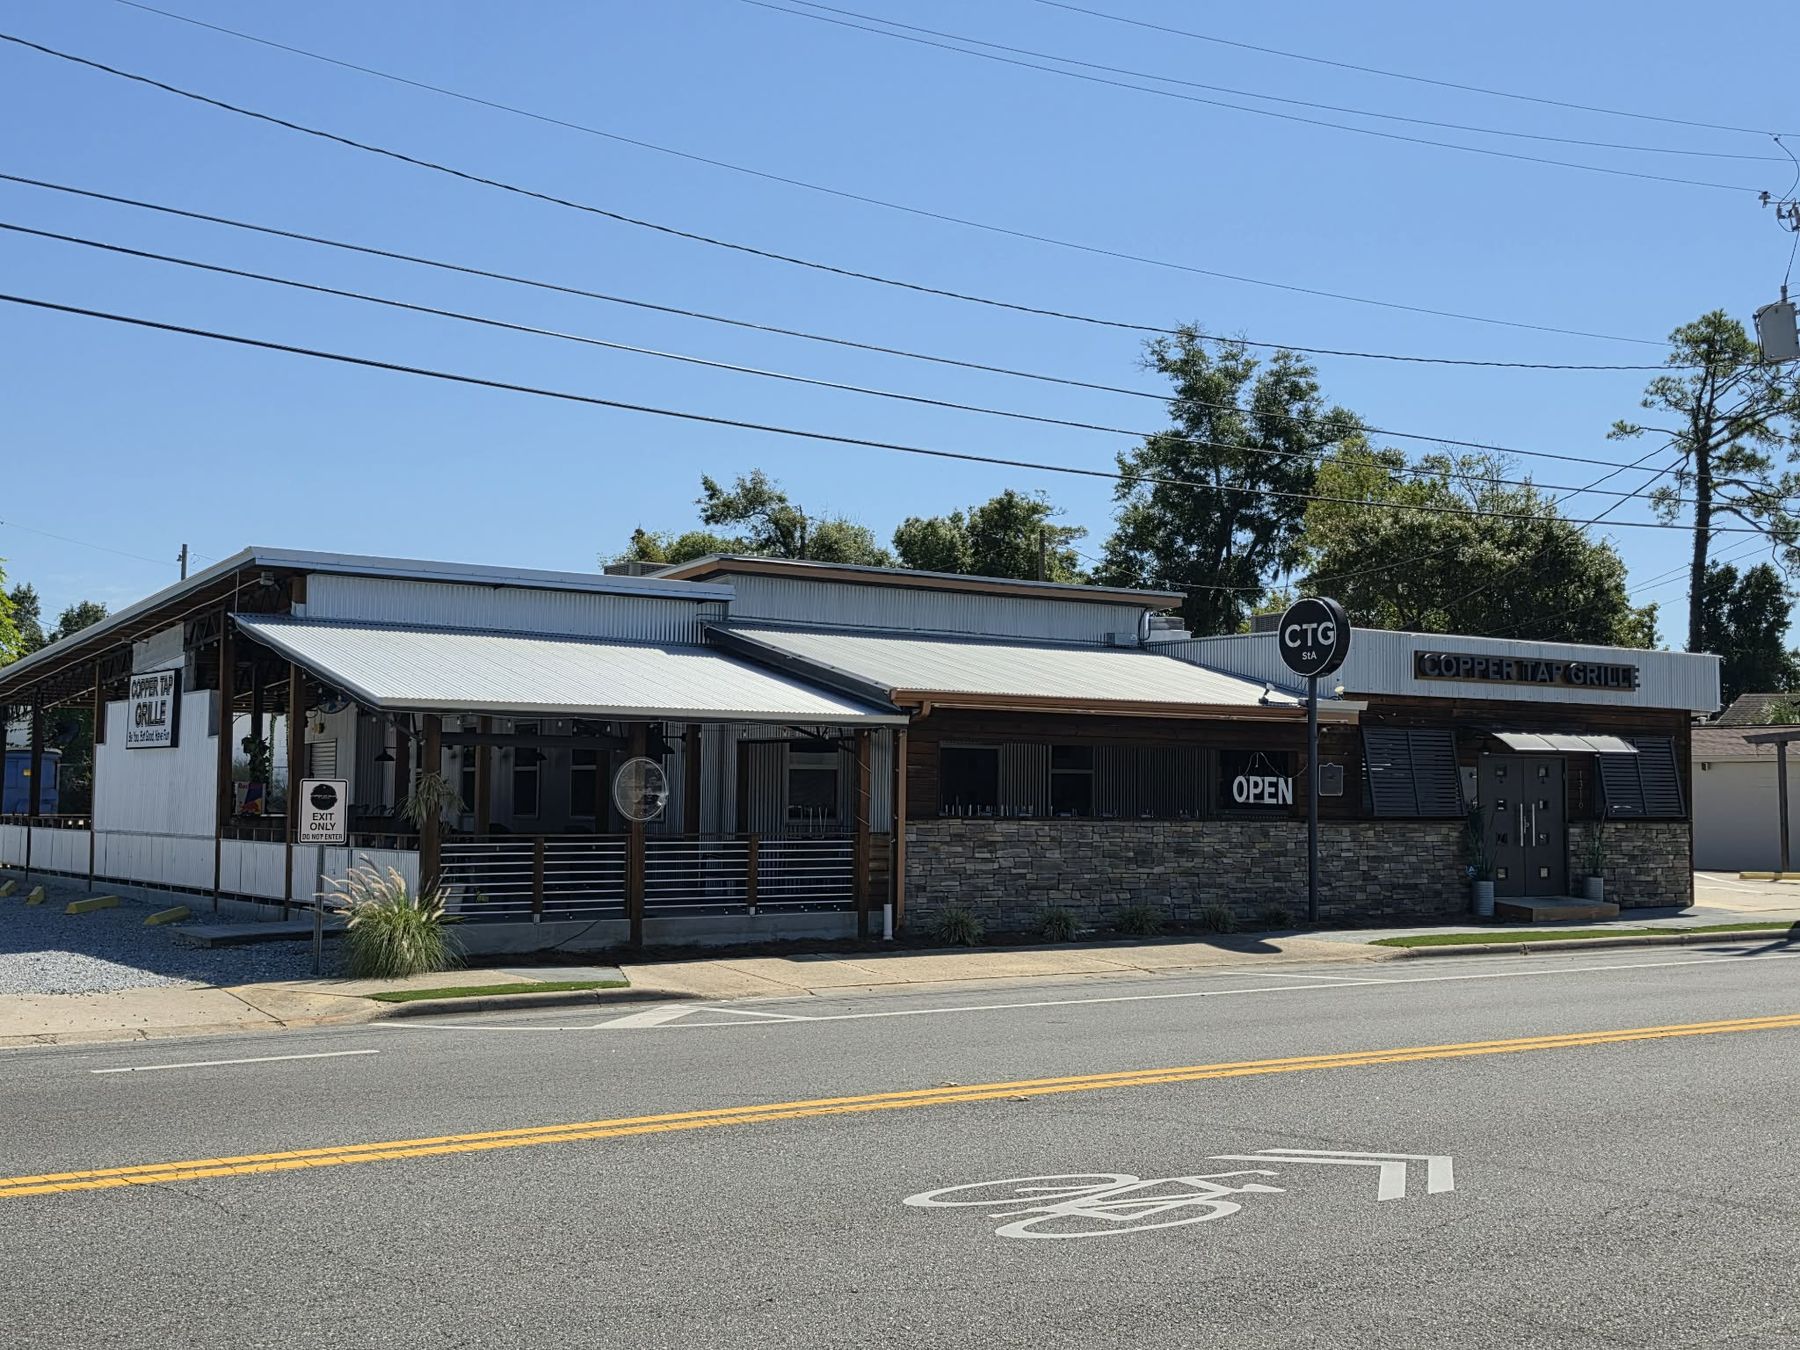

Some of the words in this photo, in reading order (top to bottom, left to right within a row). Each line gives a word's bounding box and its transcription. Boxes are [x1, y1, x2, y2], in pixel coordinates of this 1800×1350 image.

[1285, 621, 1335, 648] CTG
[1302, 651, 1317, 660] StA
[1421, 653, 1516, 681] COPPER
[1522, 661, 1563, 683] TAP
[1567, 663, 1640, 688] GRILLE
[131, 676, 159, 700] COPPER
[160, 674, 174, 697] TAP
[135, 699, 167, 729] GRILLE
[1232, 775, 1293, 804] OPEN
[310, 822, 336, 831] ONLY
[312, 812, 335, 821] EXIT
